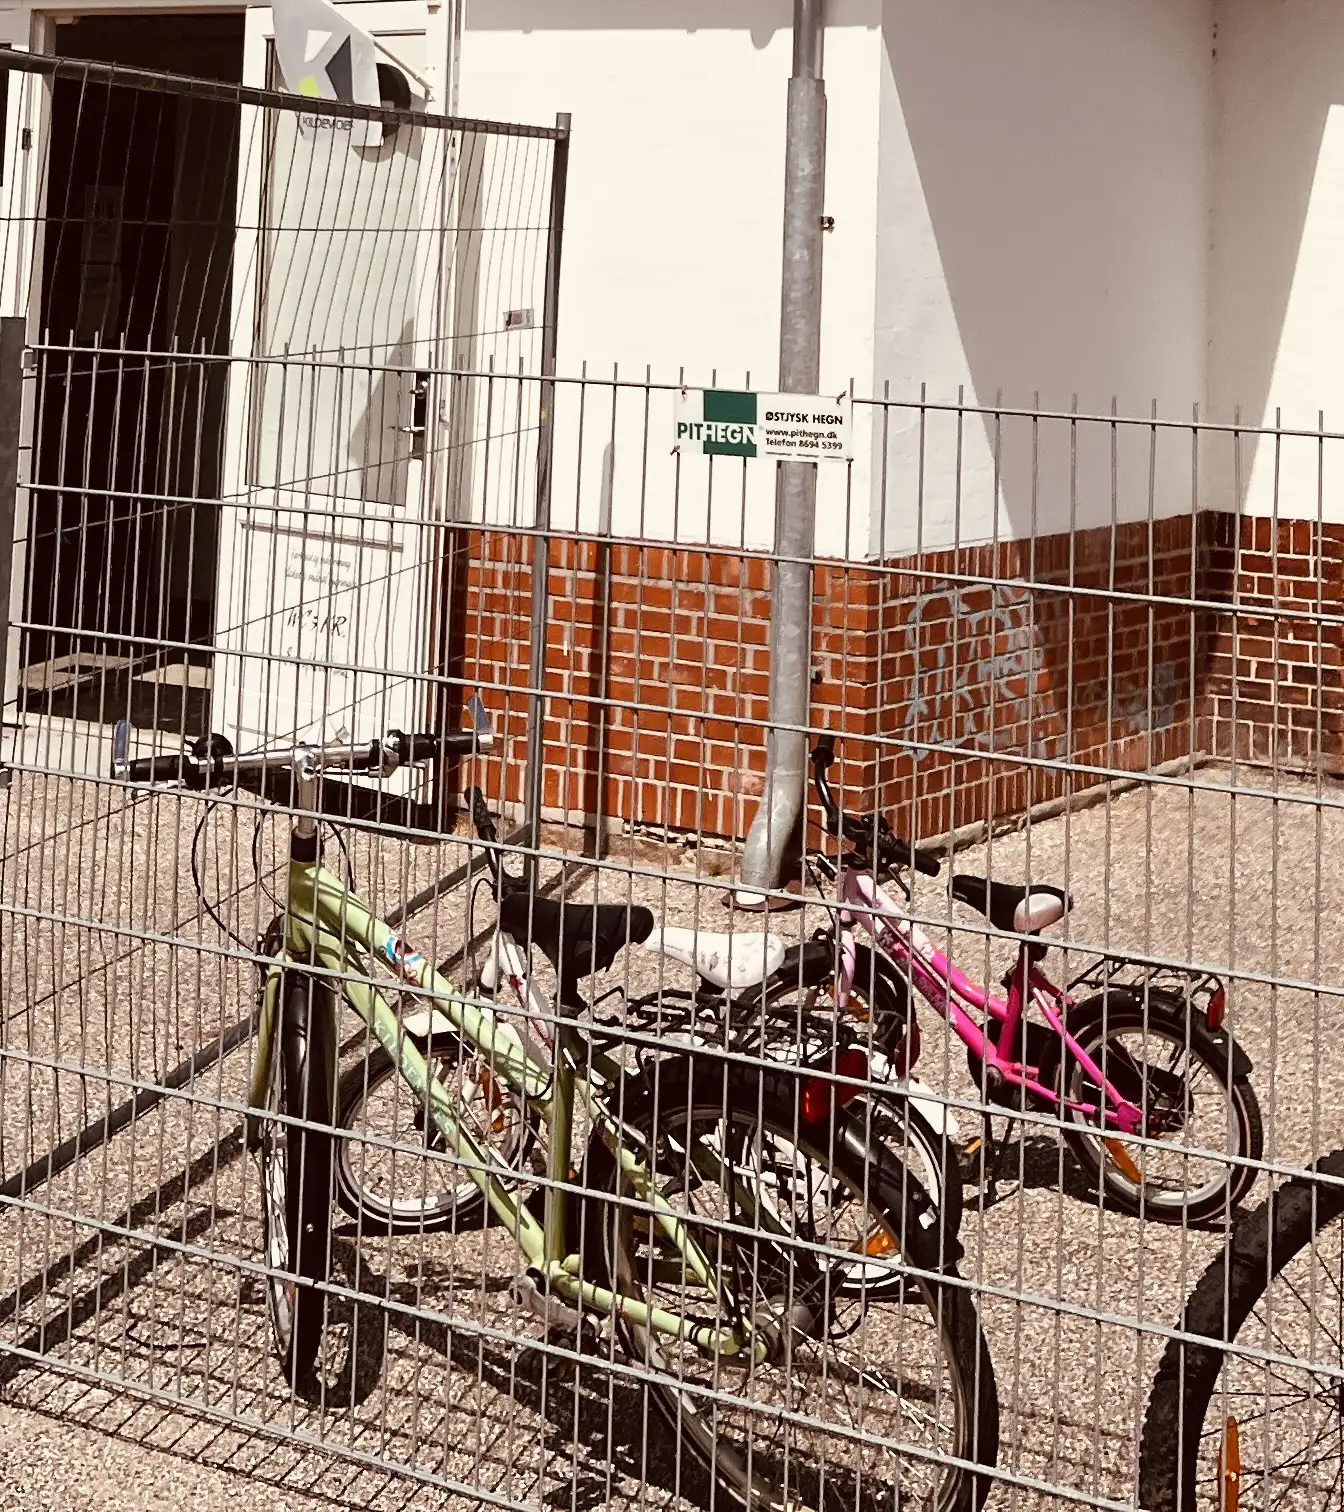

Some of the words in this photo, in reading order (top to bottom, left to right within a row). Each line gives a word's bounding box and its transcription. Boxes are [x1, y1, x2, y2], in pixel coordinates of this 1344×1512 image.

[765, 411, 809, 424] ØSTJYSK
[812, 414, 843, 425] HEGN
[677, 421, 757, 445] PITHEGN
[765, 437, 797, 448] Telefon
[371, 1017, 458, 1136] KILDEMES
